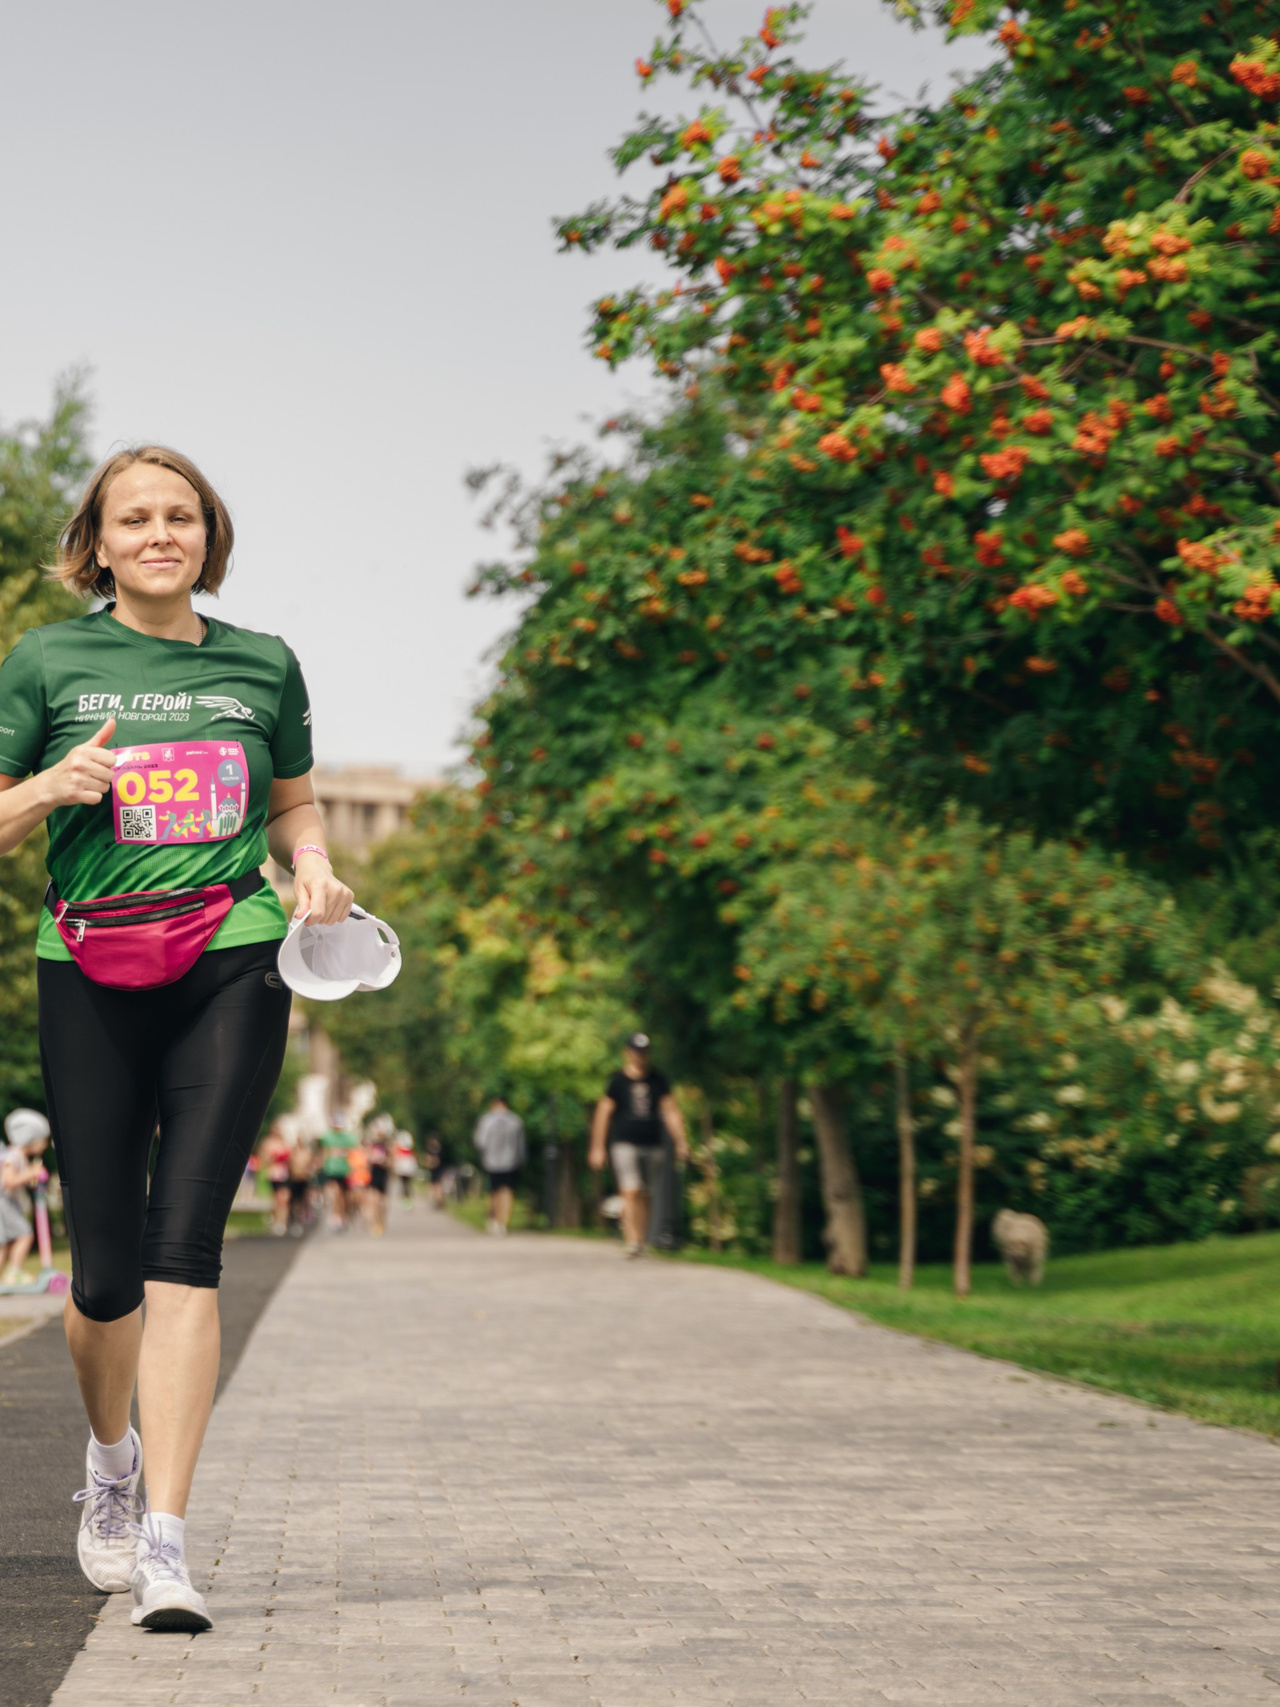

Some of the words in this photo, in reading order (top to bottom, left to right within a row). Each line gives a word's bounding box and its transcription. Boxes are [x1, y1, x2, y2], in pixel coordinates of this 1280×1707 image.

[78, 693, 125, 713] БЕГИ,
[131, 691, 193, 711] ГЕРОЙ!
[118, 711, 167, 722] НОВГОРОД
[168, 712, 190, 722] 2023
[225, 763, 234, 776] 1
[116, 768, 200, 805] 052
